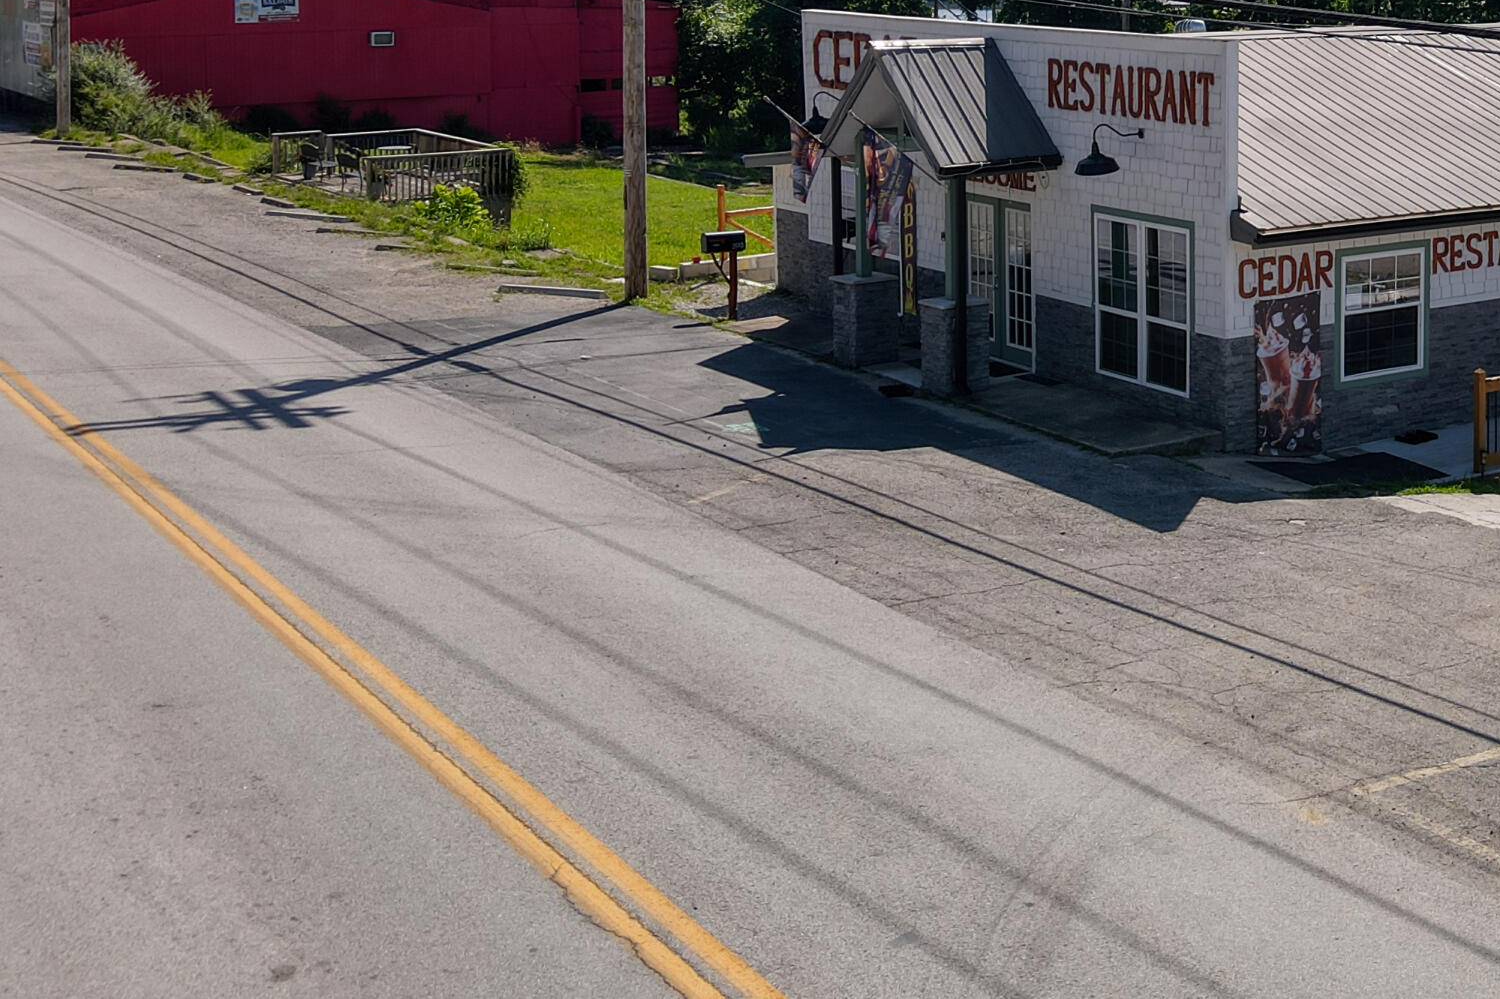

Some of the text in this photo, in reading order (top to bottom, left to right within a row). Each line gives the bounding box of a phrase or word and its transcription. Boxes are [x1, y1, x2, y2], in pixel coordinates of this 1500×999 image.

[1047, 58, 1215, 127] RESTAURANT
[903, 202, 914, 291] BBQ
[1238, 250, 1334, 300] CEDAR
